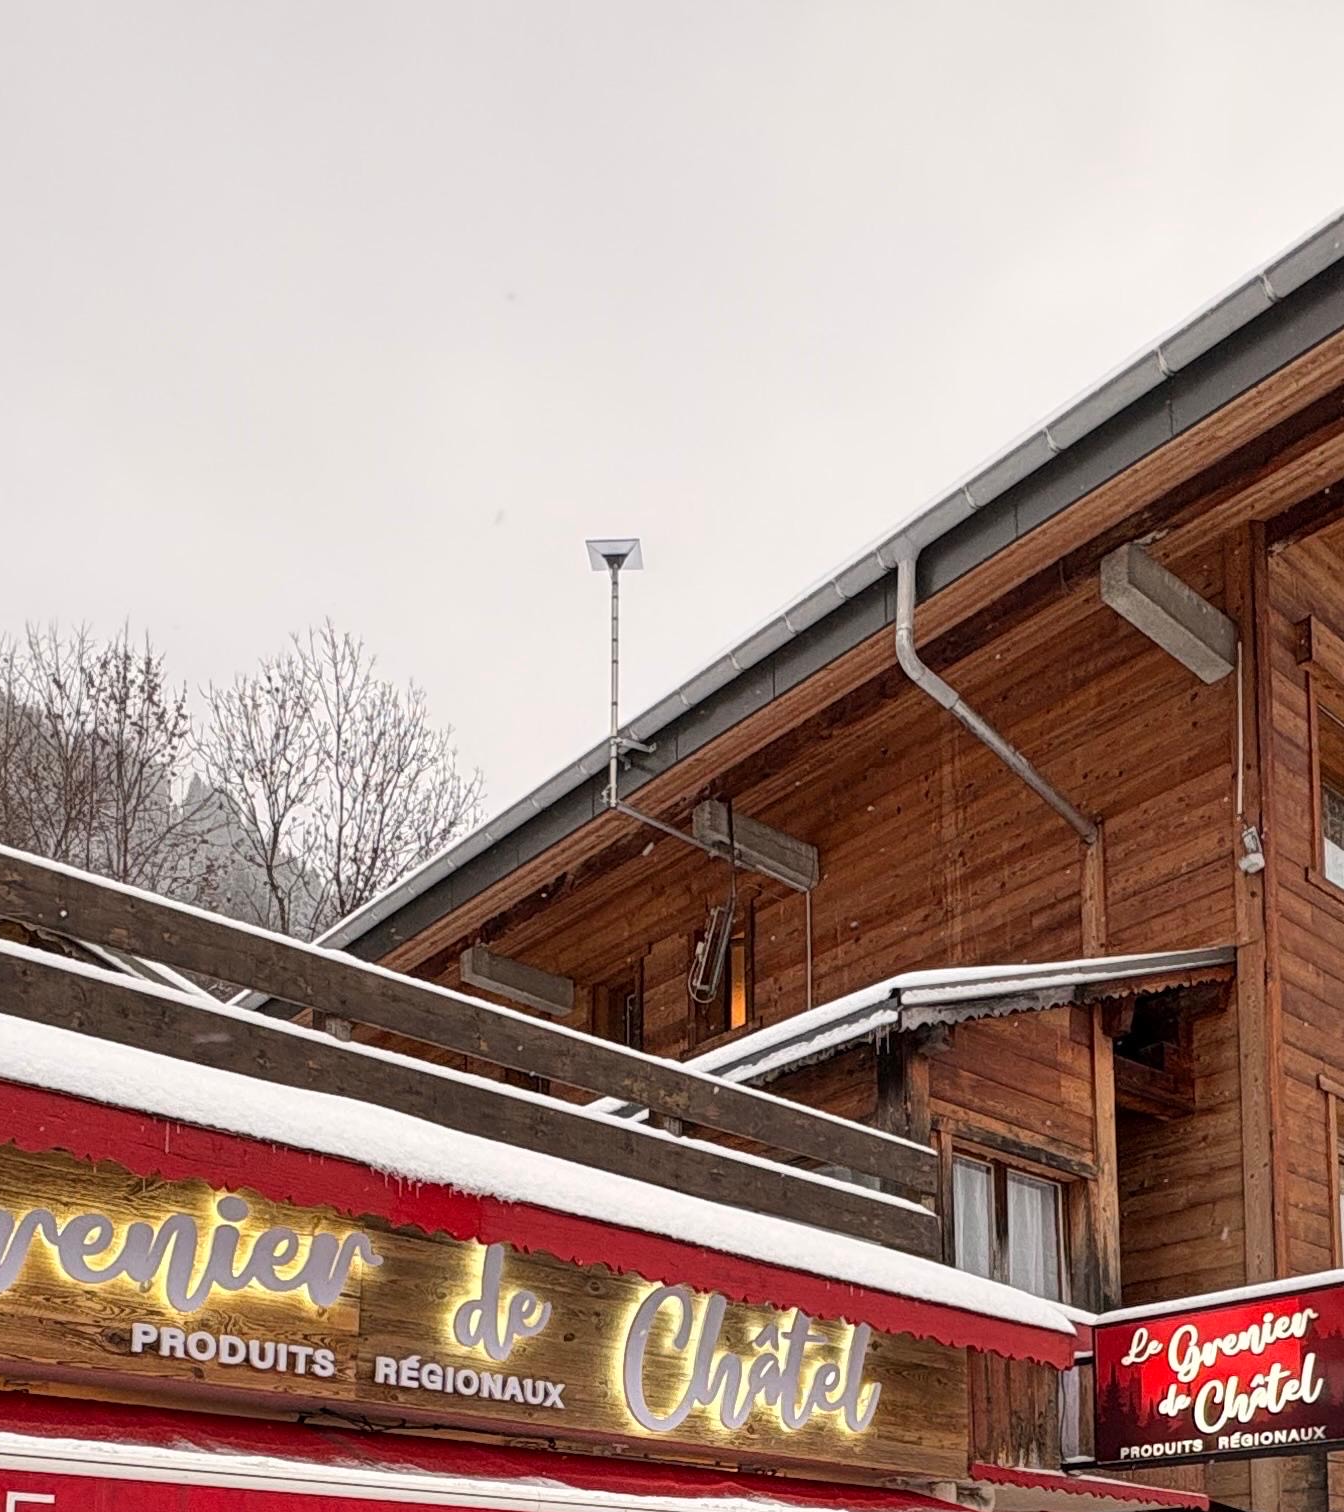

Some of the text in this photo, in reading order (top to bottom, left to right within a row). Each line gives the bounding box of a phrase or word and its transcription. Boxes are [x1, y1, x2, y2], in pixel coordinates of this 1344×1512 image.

[130, 1322, 566, 1410] PRODUITS RÉGIONAUX
[454, 1243, 553, 1362] de
[622, 1284, 882, 1433] Châtel
[1120, 1307, 1320, 1384] Le Grenier
[1158, 1352, 1325, 1435] de Châtel
[1119, 1425, 1328, 1460] PRODUITS RÉGIONAUX
